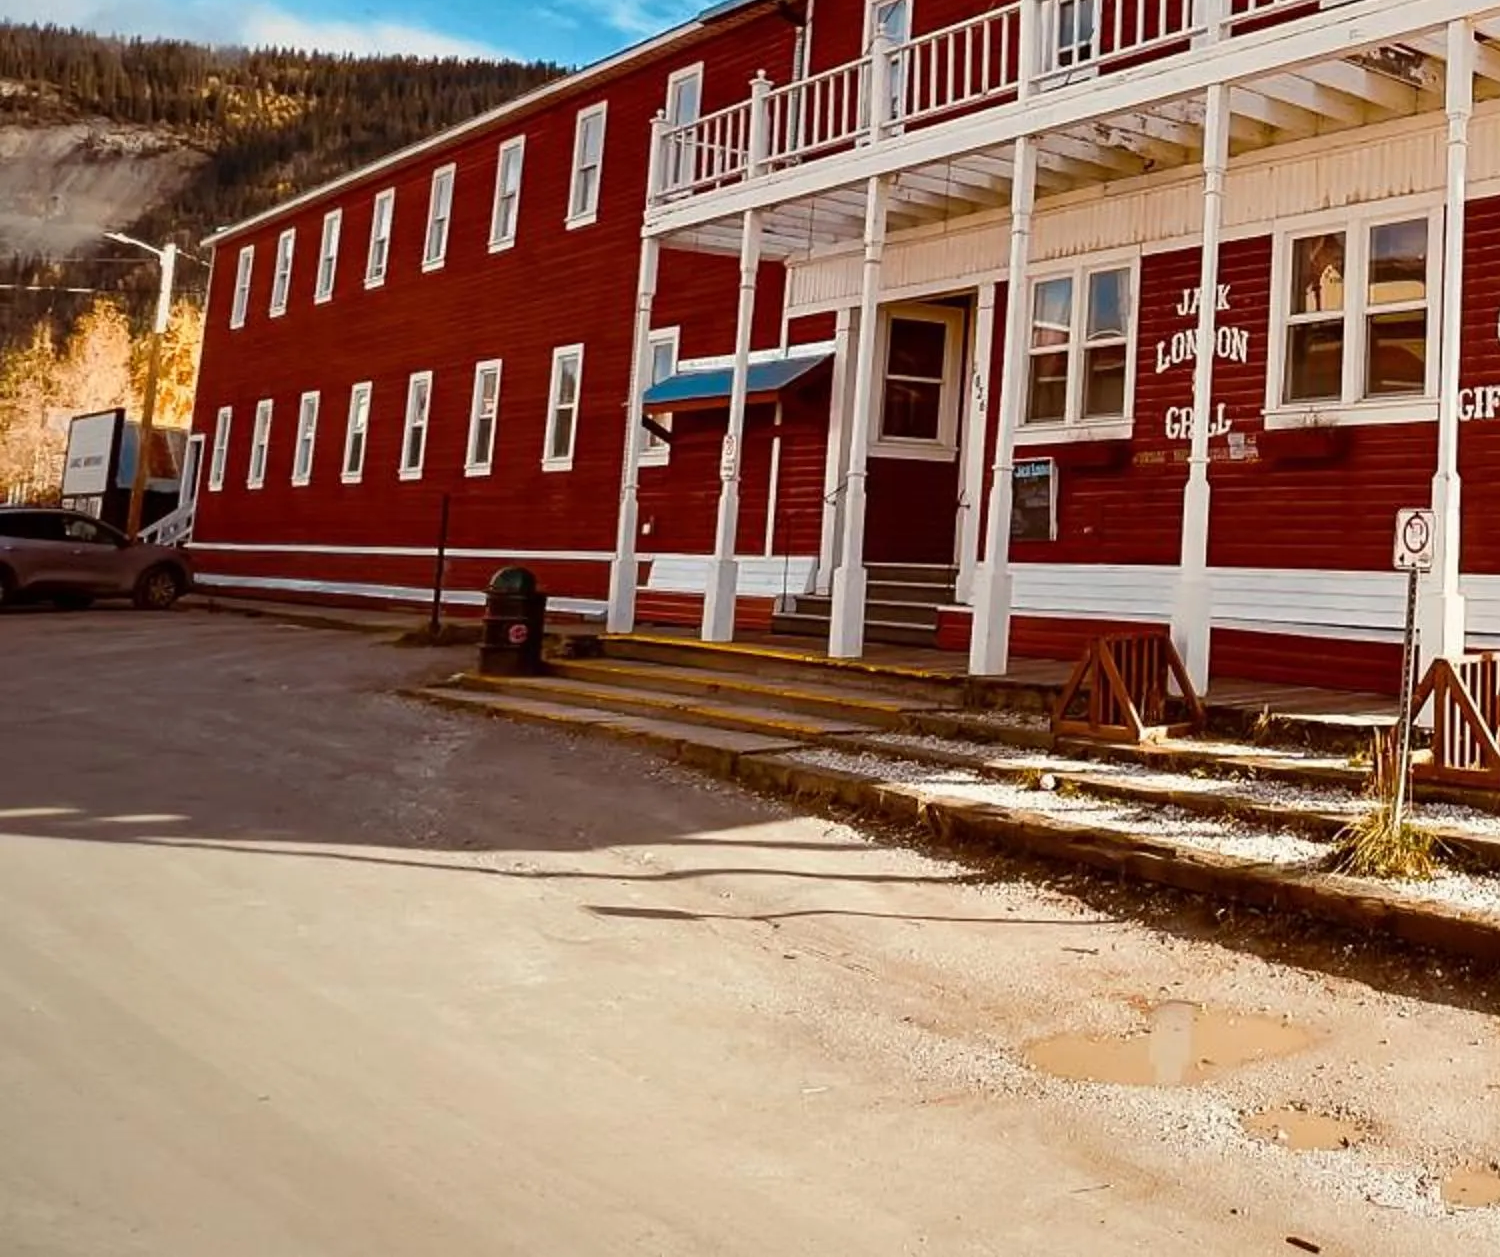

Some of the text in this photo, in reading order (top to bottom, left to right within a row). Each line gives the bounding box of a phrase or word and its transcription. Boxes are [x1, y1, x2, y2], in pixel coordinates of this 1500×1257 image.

[1176, 284, 1231, 315] JAK
[1156, 326, 1249, 373] LONON
[1165, 403, 1232, 439] GRL
